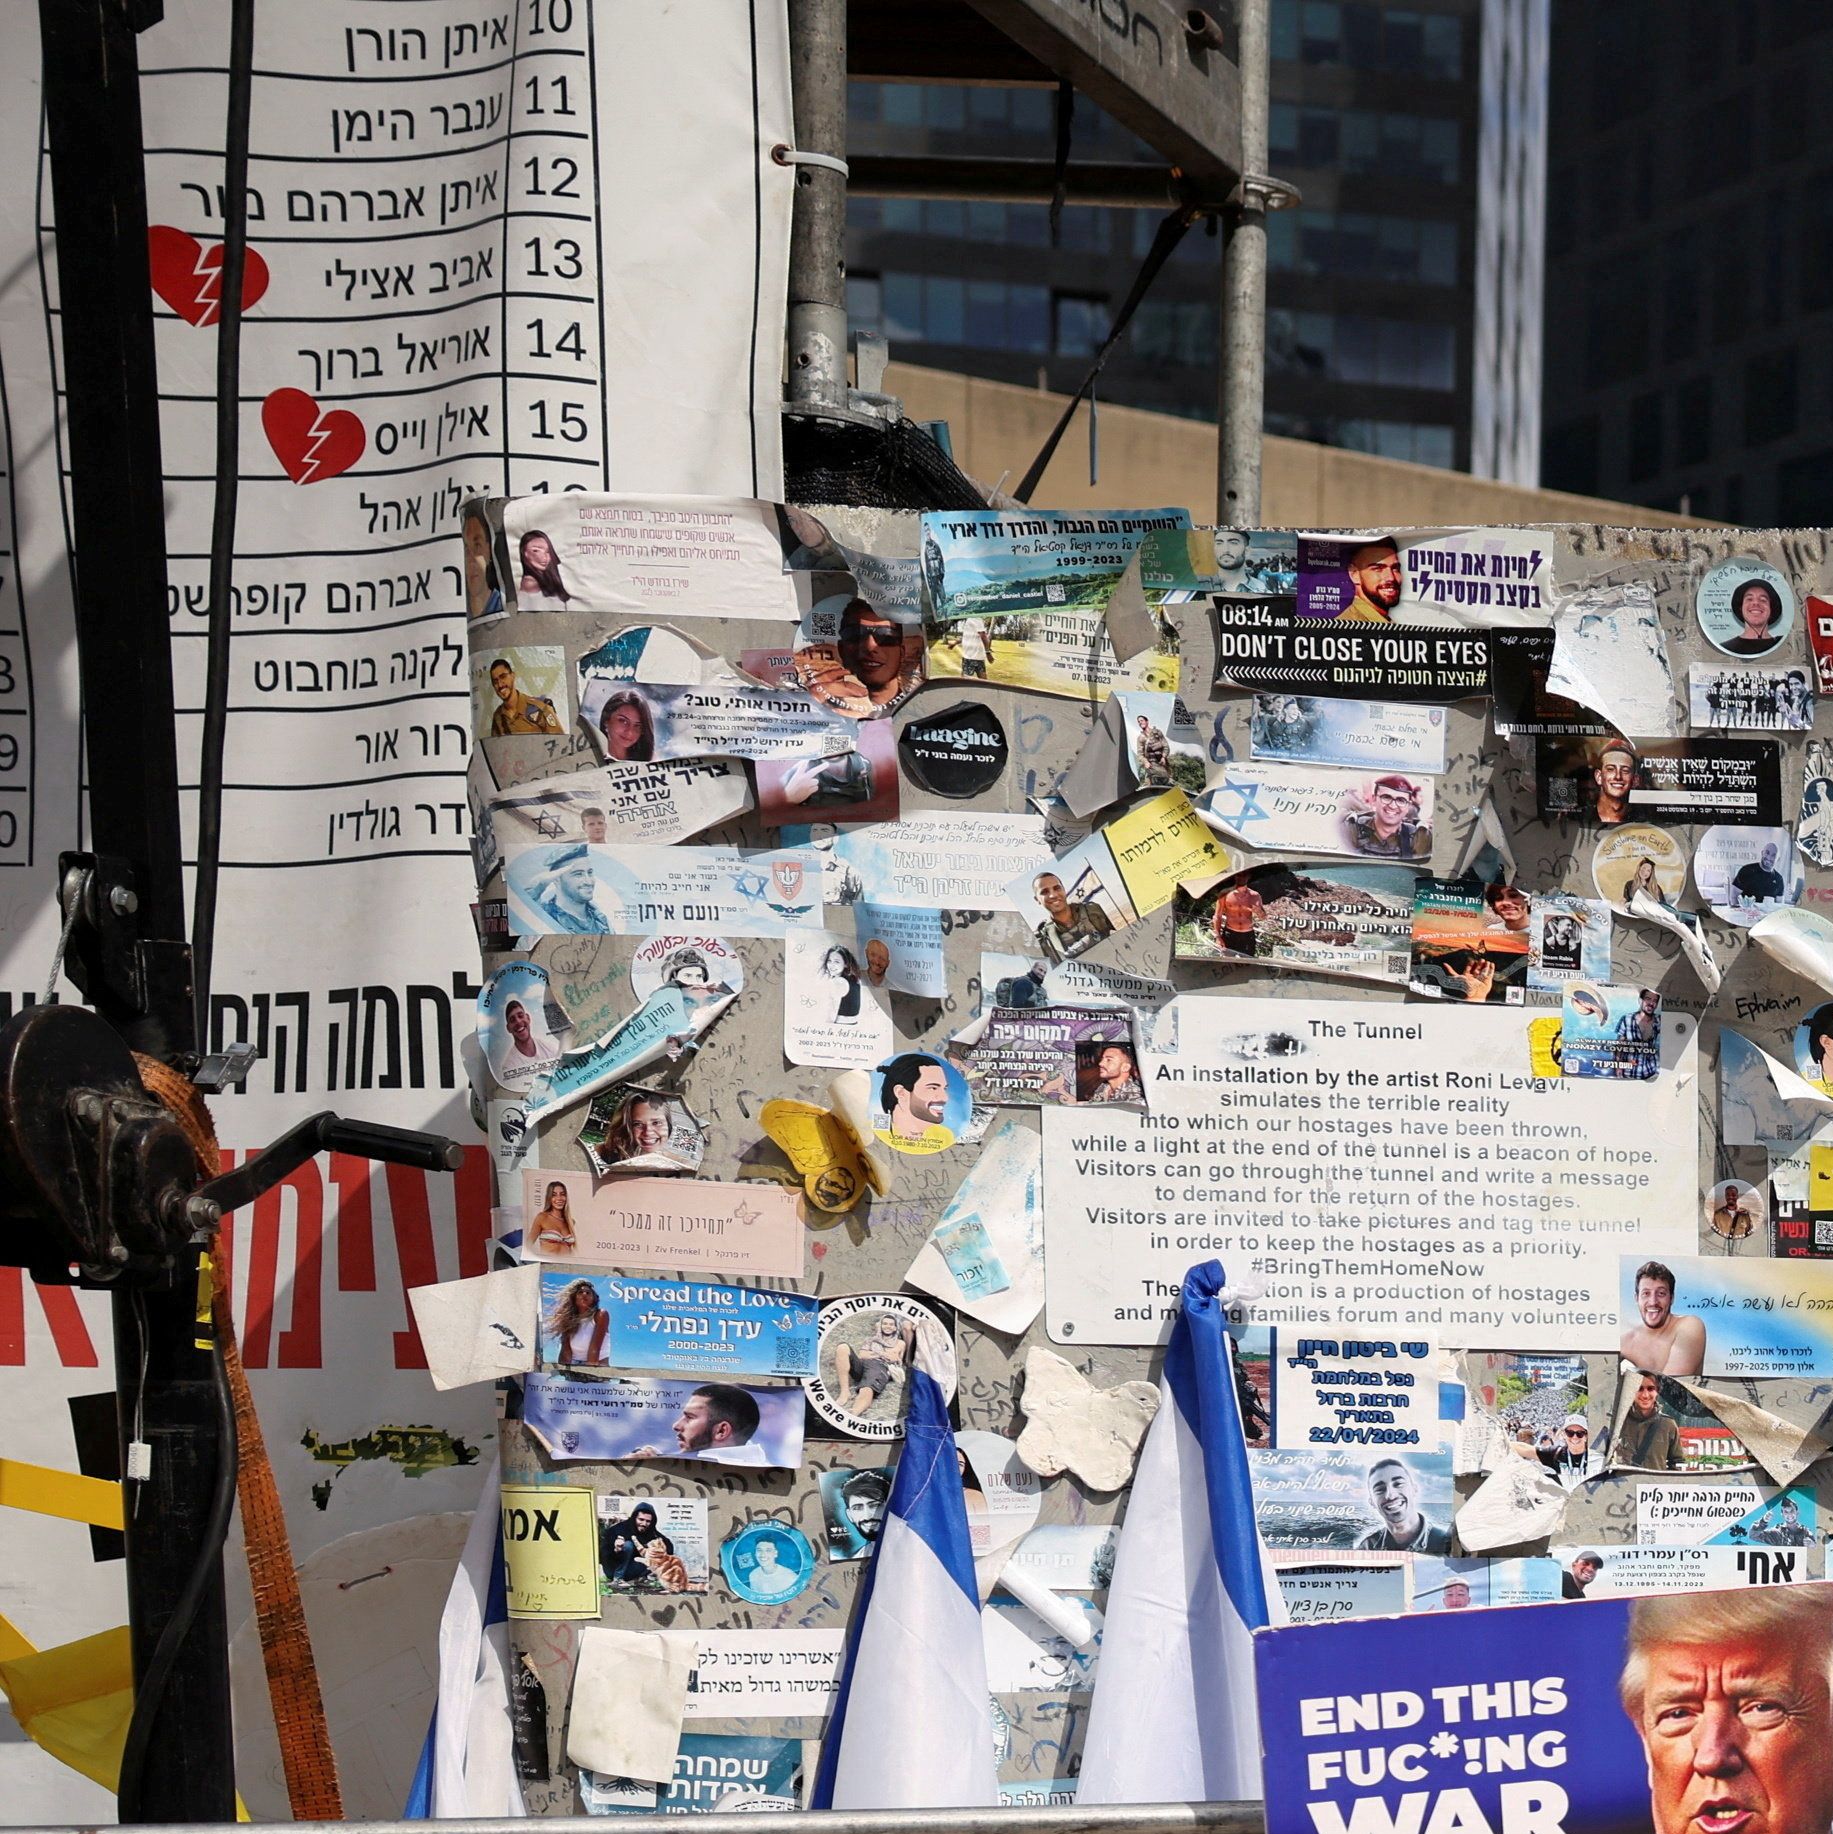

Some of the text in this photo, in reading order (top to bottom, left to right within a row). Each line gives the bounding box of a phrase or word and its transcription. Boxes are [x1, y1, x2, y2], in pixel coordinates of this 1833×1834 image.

[521, 0, 581, 33] 10
[345, 15, 515, 72] איתן הורן
[526, 76, 576, 116] 11
[332, 94, 510, 153] ענבר הימן
[524, 157, 580, 198] 12
[287, 171, 497, 225] איתן אברהם
[325, 250, 493, 301] אביב אצילי
[525, 237, 582, 279] 13
[527, 319, 586, 361] 14
[298, 327, 490, 392] אוריאל ברוך
[375, 403, 490, 456] אילן וייס
[529, 400, 587, 442] 15
[1222, 603, 1289, 627] 08:14 AM
[1222, 633, 1487, 665] DON'T CLOSE YOUR EYES
[1334, 666, 1487, 686] #הצצה חטופה לגיהנום
[1308, 1020, 1422, 1040] The Tunnel
[1156, 1064, 1570, 1093] An installation by the artist Roni Levavi,
[1221, 1090, 1510, 1116] simulates the terrible reality
[1134, 1110, 1587, 1138] into which our hostages have been thrown,
[1251, 1258, 1484, 1279] #BringThemHomeNow
[610, 1282, 791, 1308] Spread the Love
[641, 1309, 760, 1340] עדן נפתלי
[669, 1340, 734, 1352] 2000-2023
[1300, 1677, 1567, 1736] END THIS
